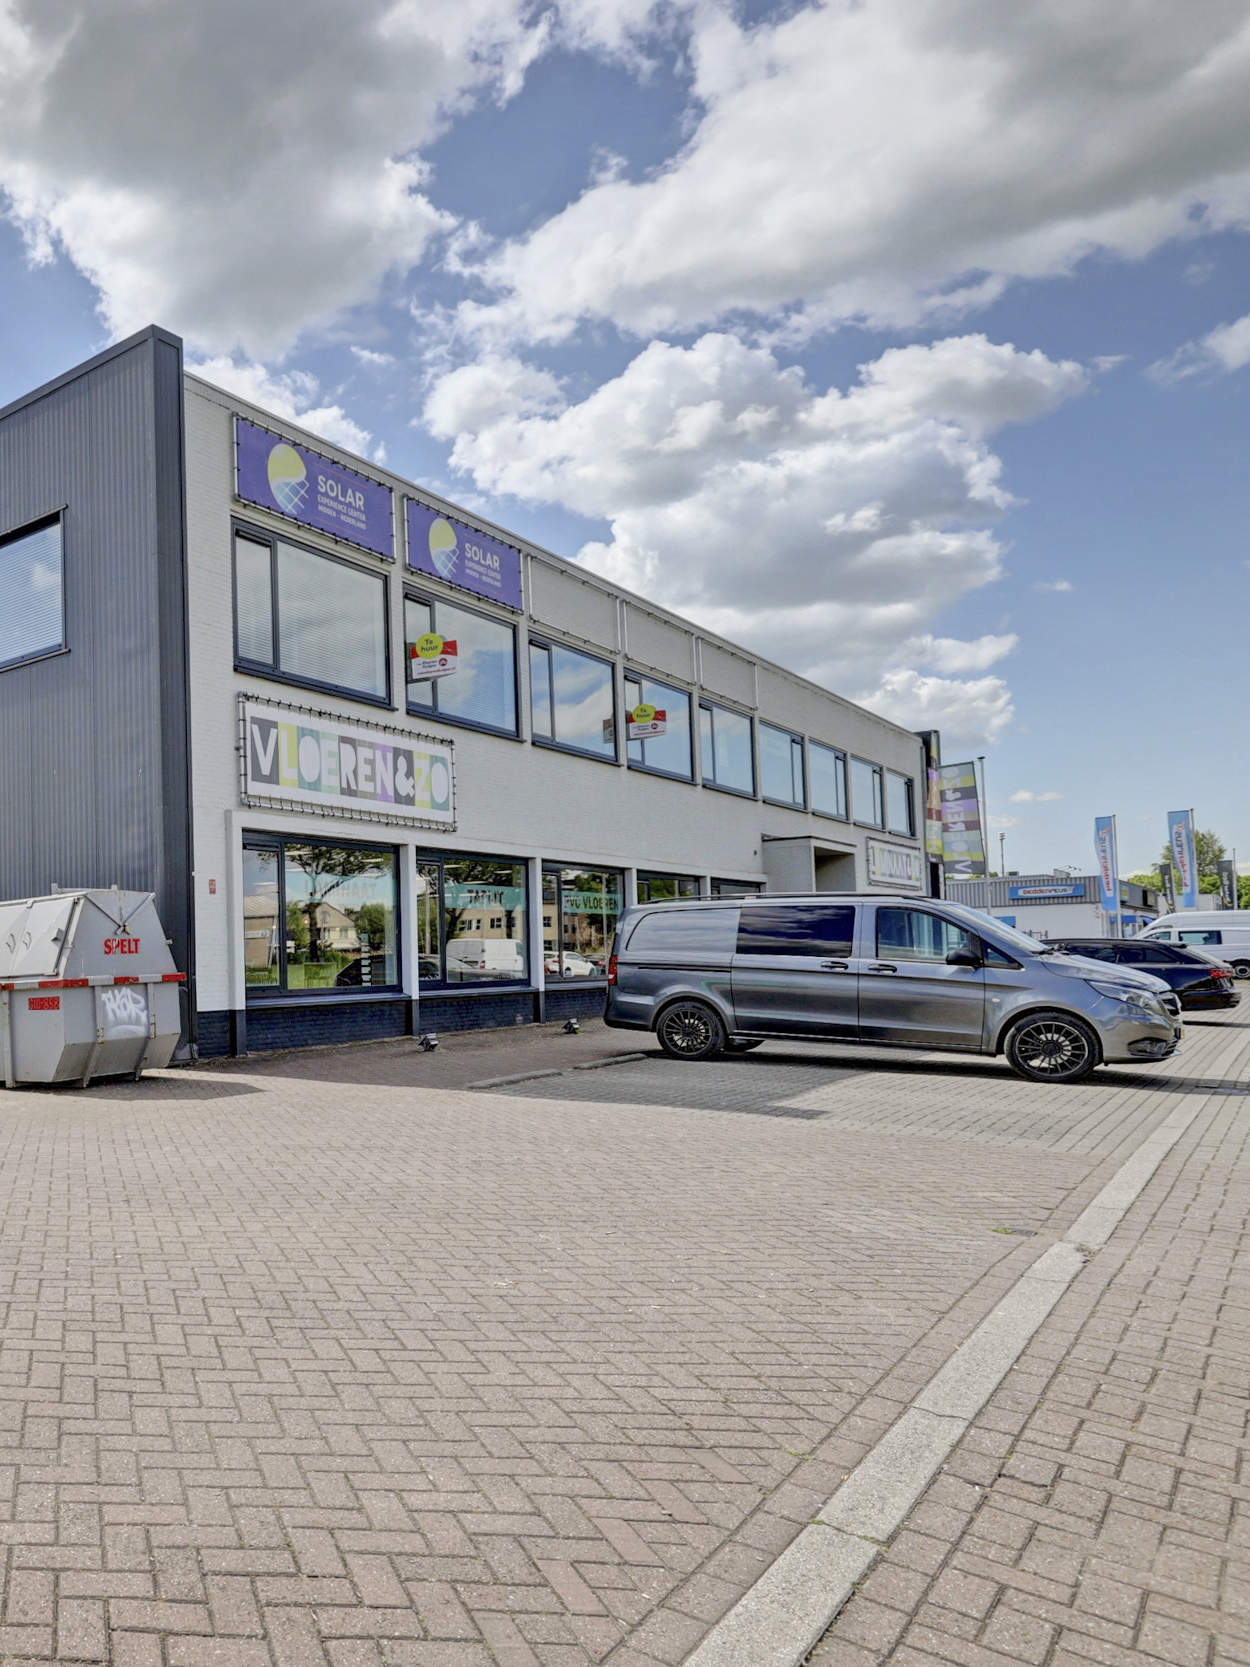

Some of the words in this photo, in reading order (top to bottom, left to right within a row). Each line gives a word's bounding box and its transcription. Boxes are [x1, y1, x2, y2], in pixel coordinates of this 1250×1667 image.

[317, 475, 365, 511] SOLAR
[317, 494, 347, 514] EXPERIENCE
[347, 507, 366, 521] CENTER
[340, 513, 367, 530] NEDERLAND
[464, 542, 500, 571] SOLAR
[421, 645, 439, 653] huur
[424, 638, 434, 646] Te
[250, 723, 449, 805] VLOEREN&ZO
[564, 895, 581, 909] PVC
[582, 896, 620, 911] VLOEREN
[103, 937, 140, 955] SPELT
